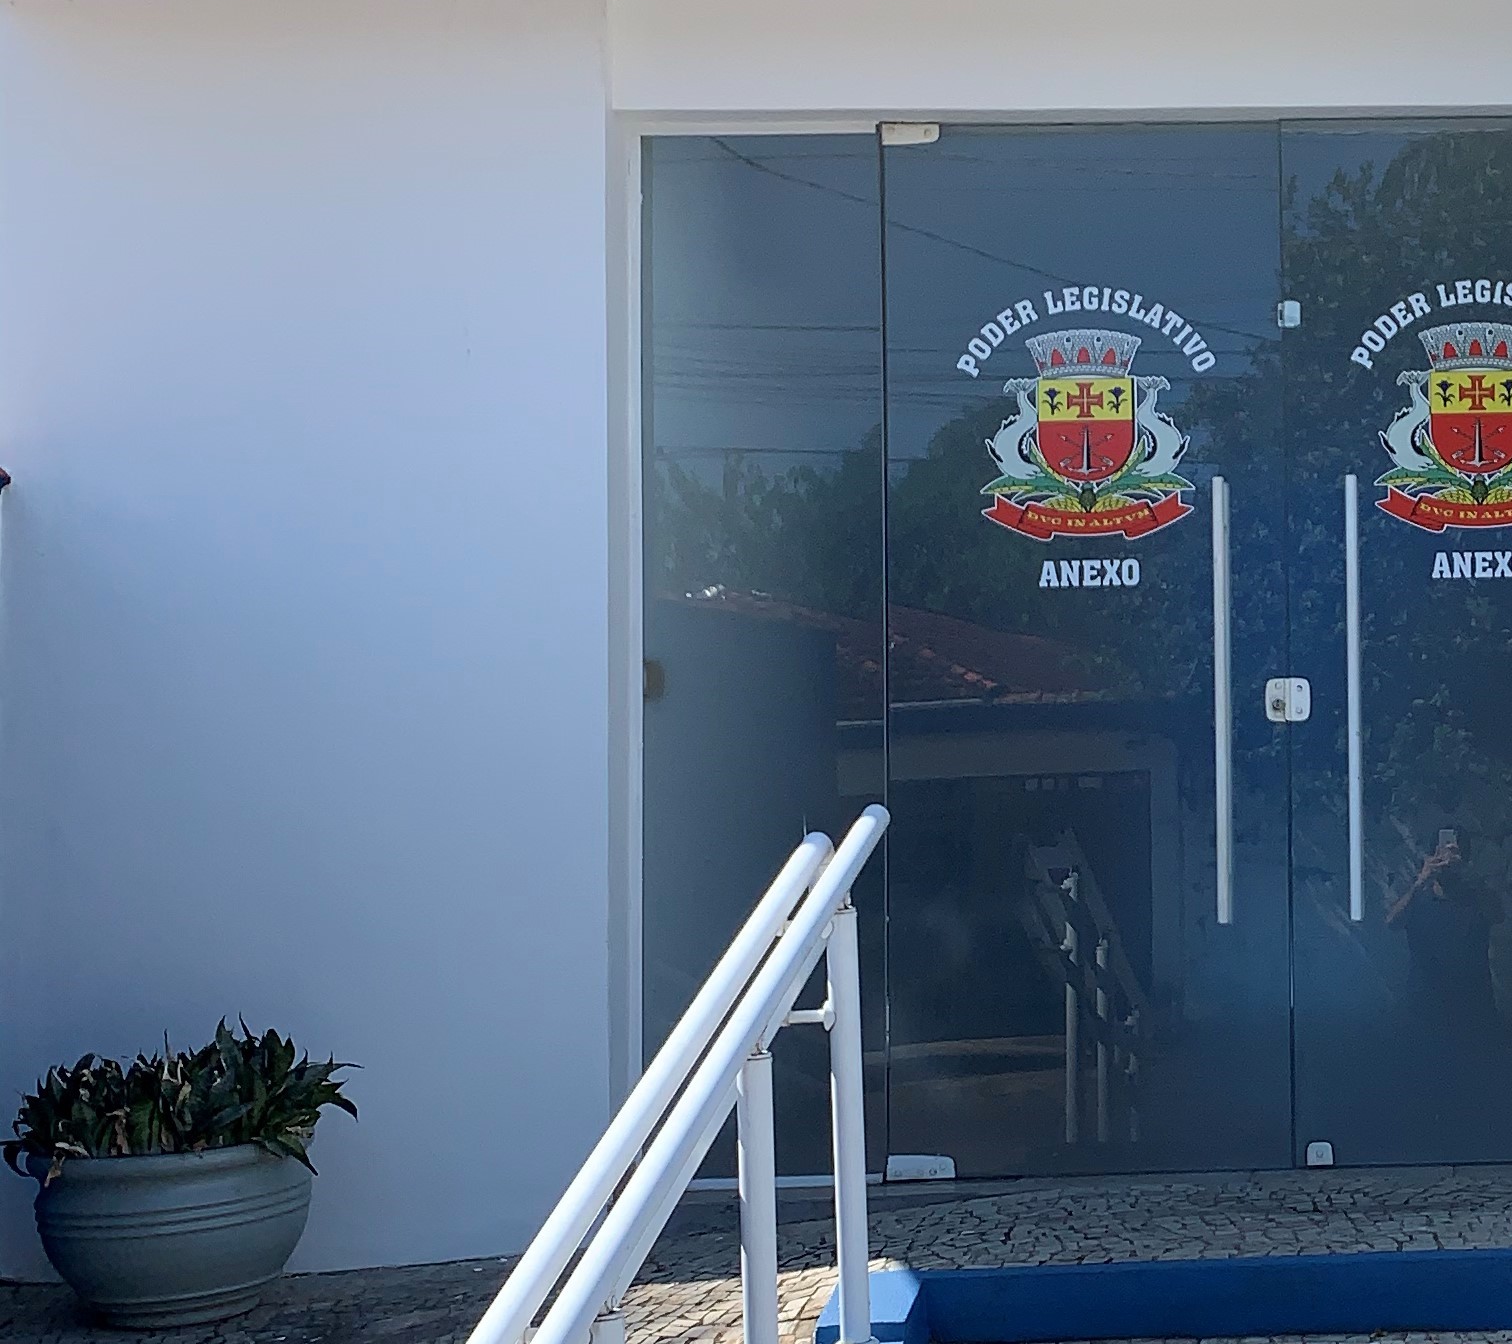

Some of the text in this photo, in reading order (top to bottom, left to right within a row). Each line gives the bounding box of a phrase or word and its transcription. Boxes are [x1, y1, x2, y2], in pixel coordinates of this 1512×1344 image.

[956, 286, 1217, 378] PODER LEGISLATIVO
[1350, 291, 1431, 369] PODER
[1067, 519, 1086, 527] IN
[1459, 510, 1478, 519] IN
[1038, 558, 1140, 587] ANEXO
